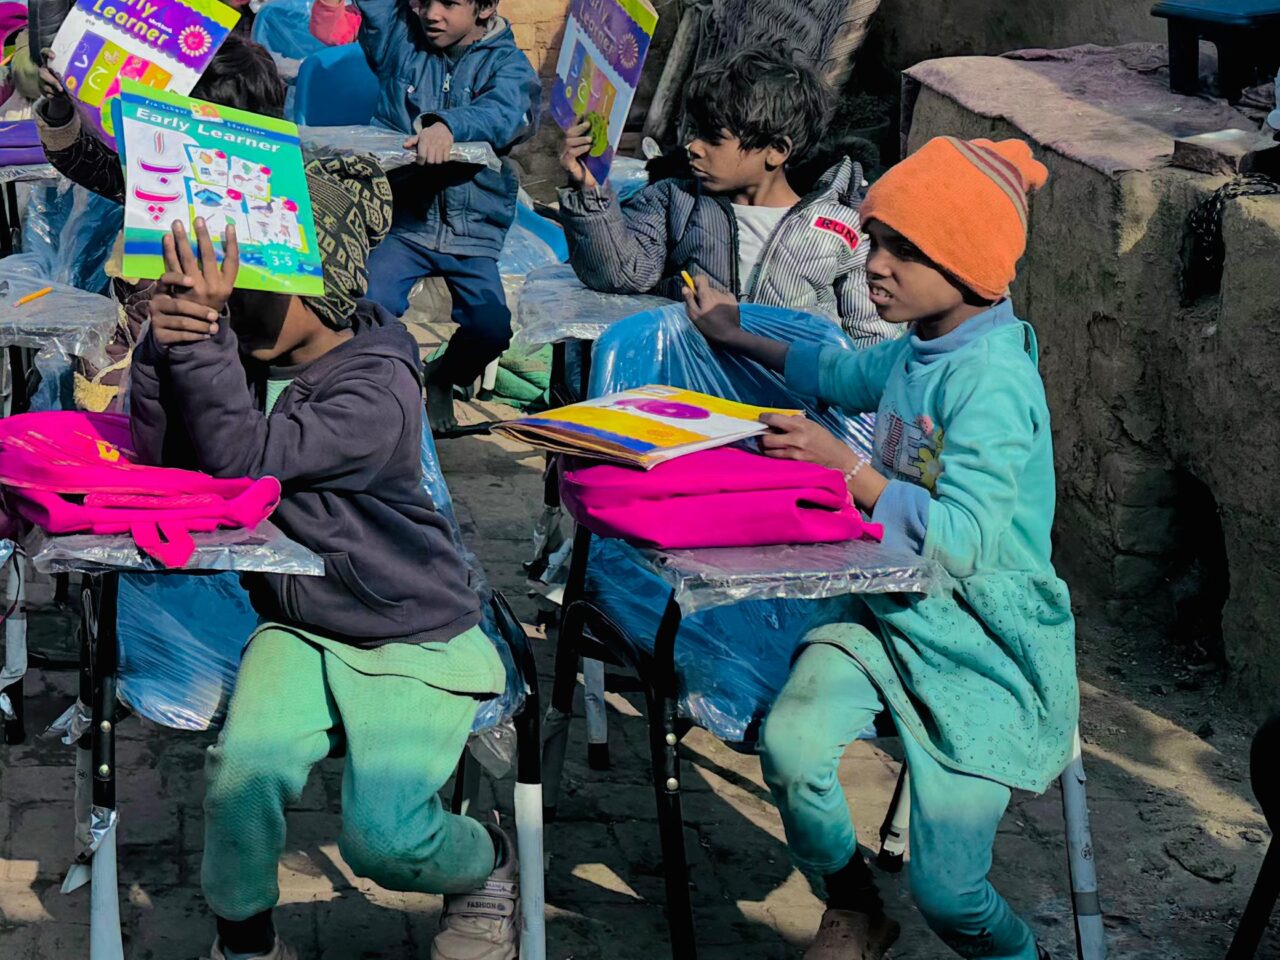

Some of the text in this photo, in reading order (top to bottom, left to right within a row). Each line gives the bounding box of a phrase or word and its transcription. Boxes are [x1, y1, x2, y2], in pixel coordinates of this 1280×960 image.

[578, 3, 616, 57] Learner
[136, 107, 281, 153] Early Learner
[822, 219, 858, 243] RUN
[271, 255, 292, 267] 3-5
[466, 901, 498, 909] FASHION
